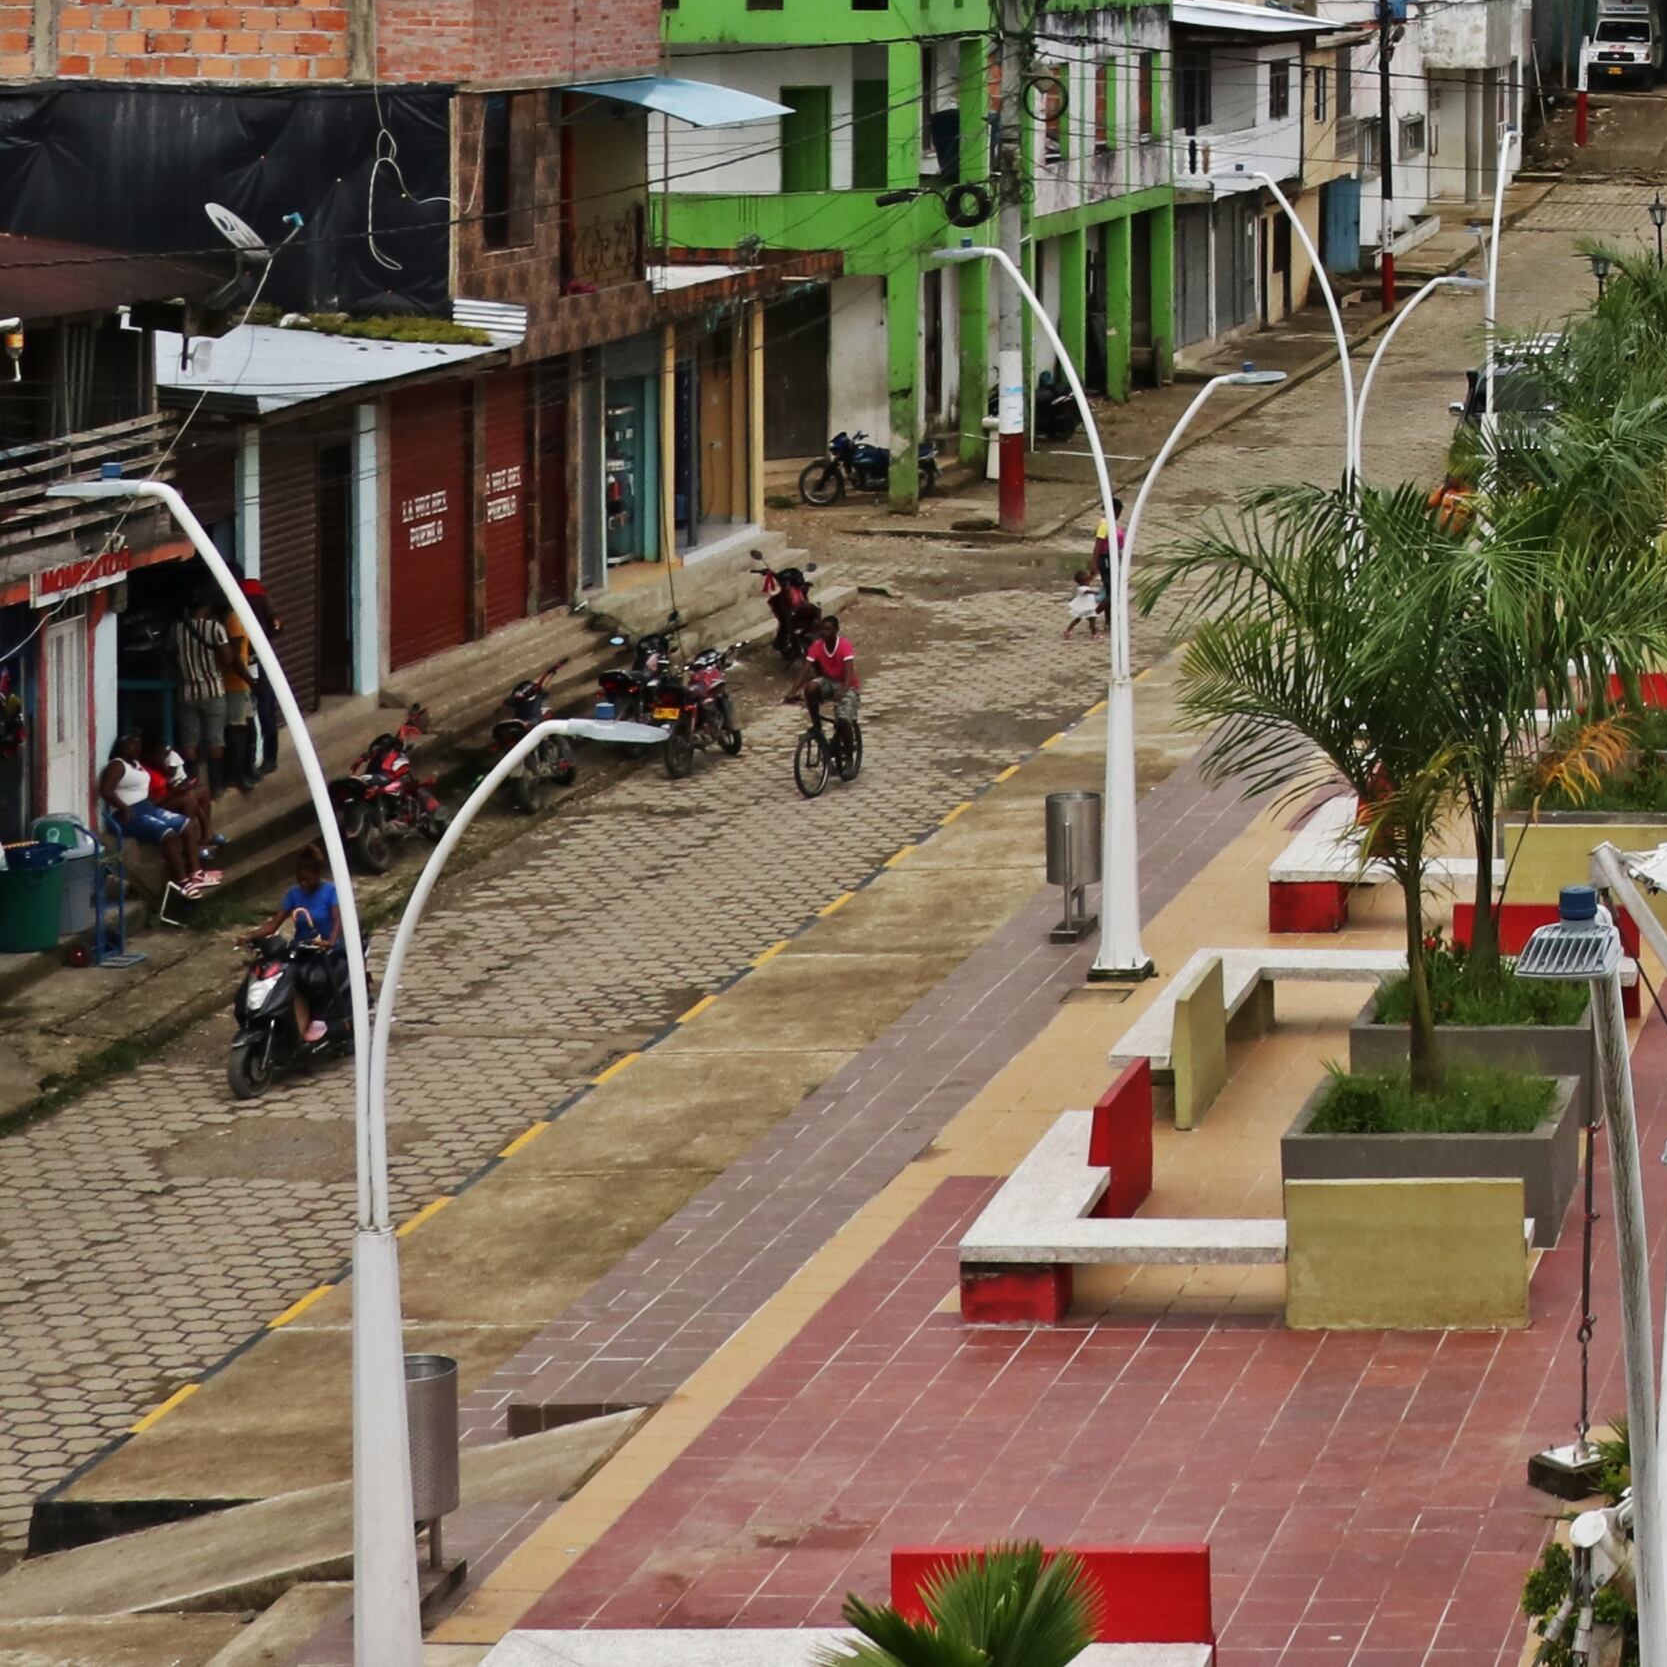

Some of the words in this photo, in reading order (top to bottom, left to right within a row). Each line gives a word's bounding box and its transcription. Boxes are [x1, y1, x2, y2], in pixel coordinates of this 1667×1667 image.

[402, 500, 414, 524] LA
[487, 494, 516, 523] PUEBLO
[410, 520, 443, 550] PUEBLO
